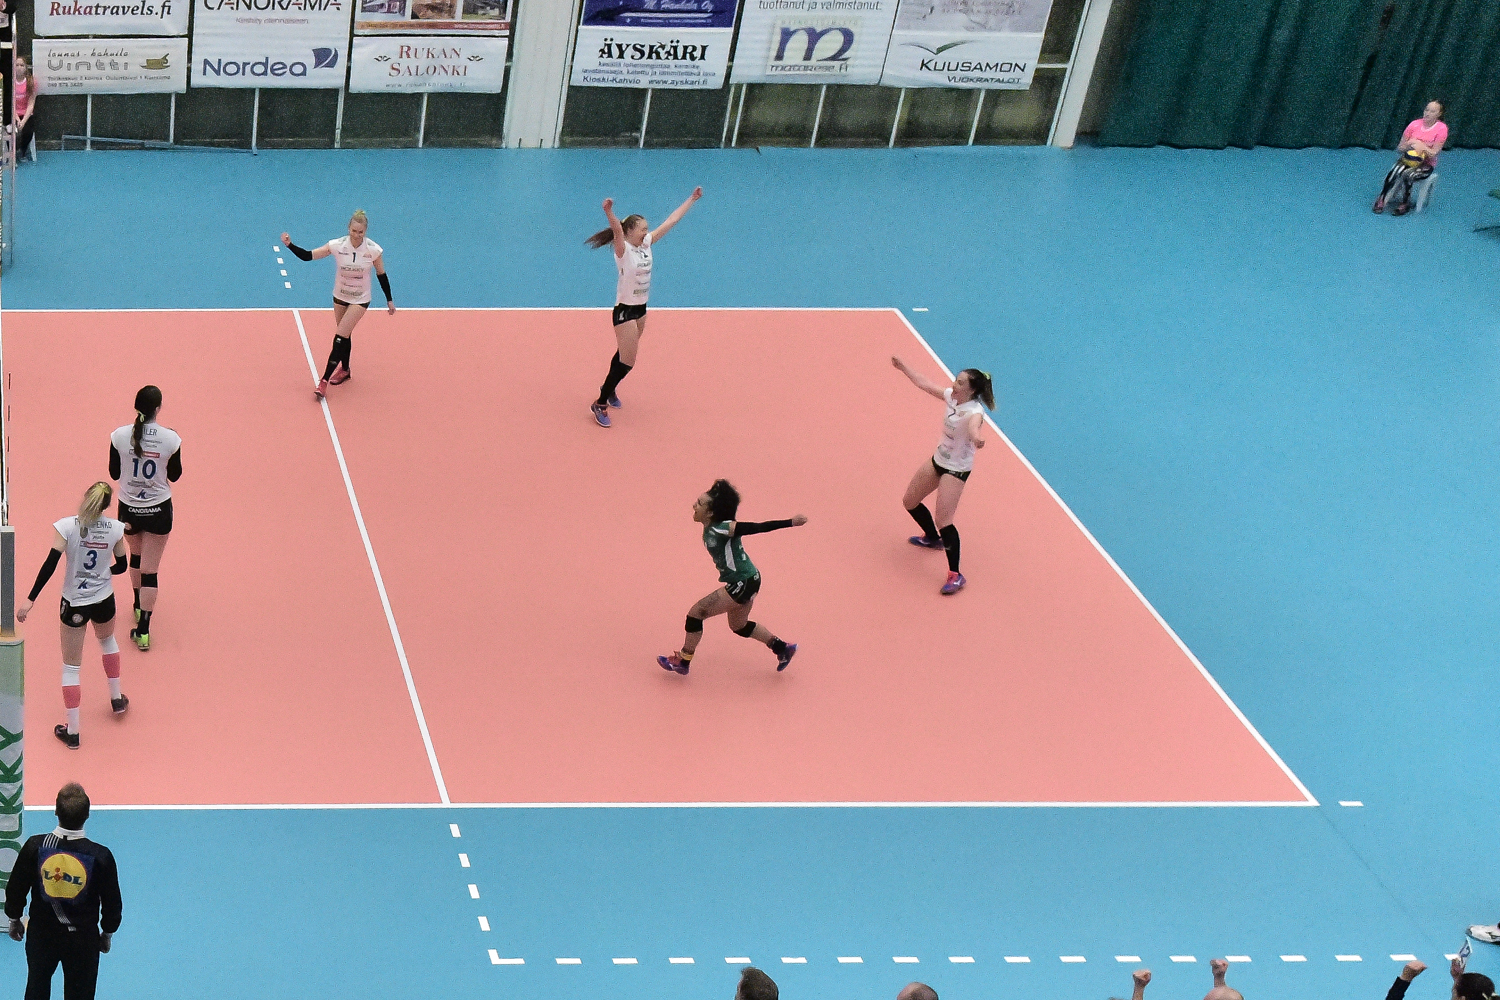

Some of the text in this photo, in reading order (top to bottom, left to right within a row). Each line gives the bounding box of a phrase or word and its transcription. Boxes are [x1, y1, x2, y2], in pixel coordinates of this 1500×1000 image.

[49, 0, 172, 19] Rukatravels.fi
[758, 0, 803, 10] tuottanut
[807, 0, 817, 11] ja
[399, 45, 462, 59] RUKAN
[598, 37, 709, 61] ÄYSKÄRI
[202, 57, 307, 77] Nordea
[388, 62, 467, 77] SALONKI
[920, 59, 1026, 73] KUUSAMON
[582, 75, 641, 85] Kioski-Kahvio
[947, 75, 1021, 84] VUOKRATALOT
[352, 252, 356, 263] 1
[132, 458, 157, 480] 10
[83, 549, 98, 570] 3
